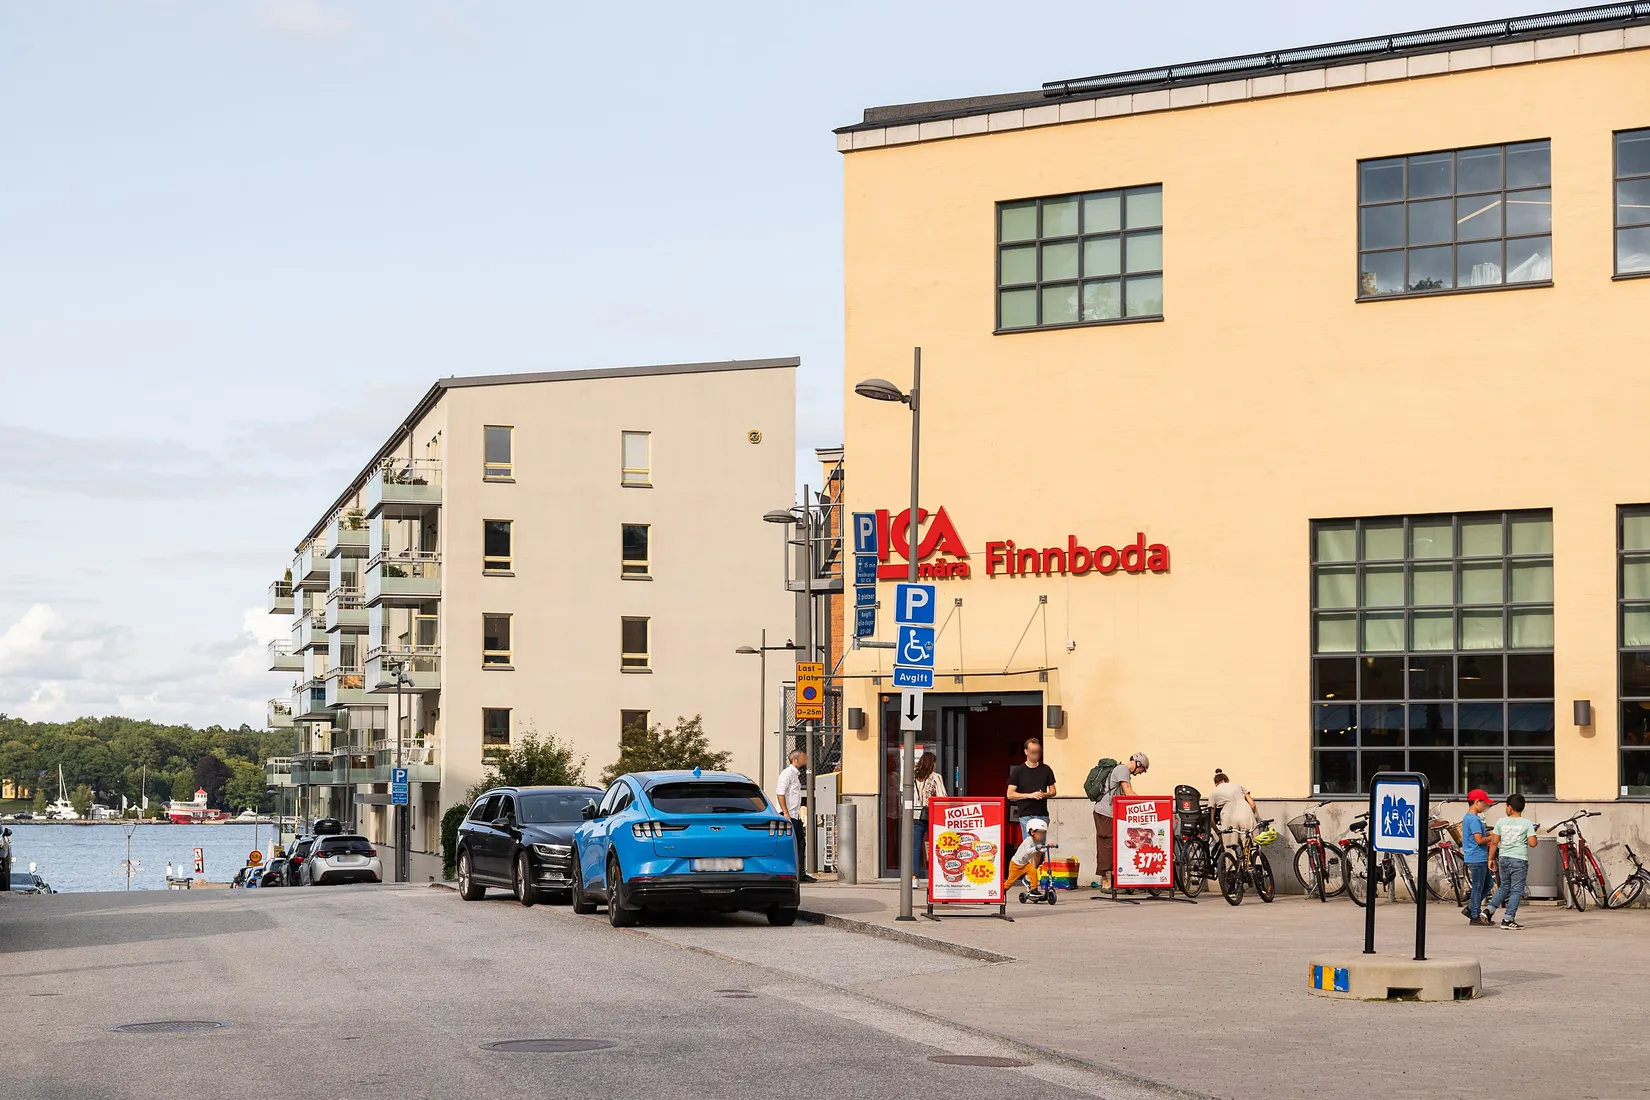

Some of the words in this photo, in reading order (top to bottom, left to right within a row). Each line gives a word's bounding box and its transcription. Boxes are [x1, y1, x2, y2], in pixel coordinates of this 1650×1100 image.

[859, 516, 874, 549] P
[875, 505, 969, 561] ICA
[985, 532, 1170, 576] Finnboda
[919, 558, 970, 578] nära
[906, 588, 929, 619] P
[900, 673, 928, 683] Avgift
[396, 769, 405, 783] P
[947, 806, 981, 819] KOLLA
[1127, 803, 1154, 815] KOLLA
[947, 819, 983, 829] PRISET!
[1127, 814, 1157, 824] PRISET!
